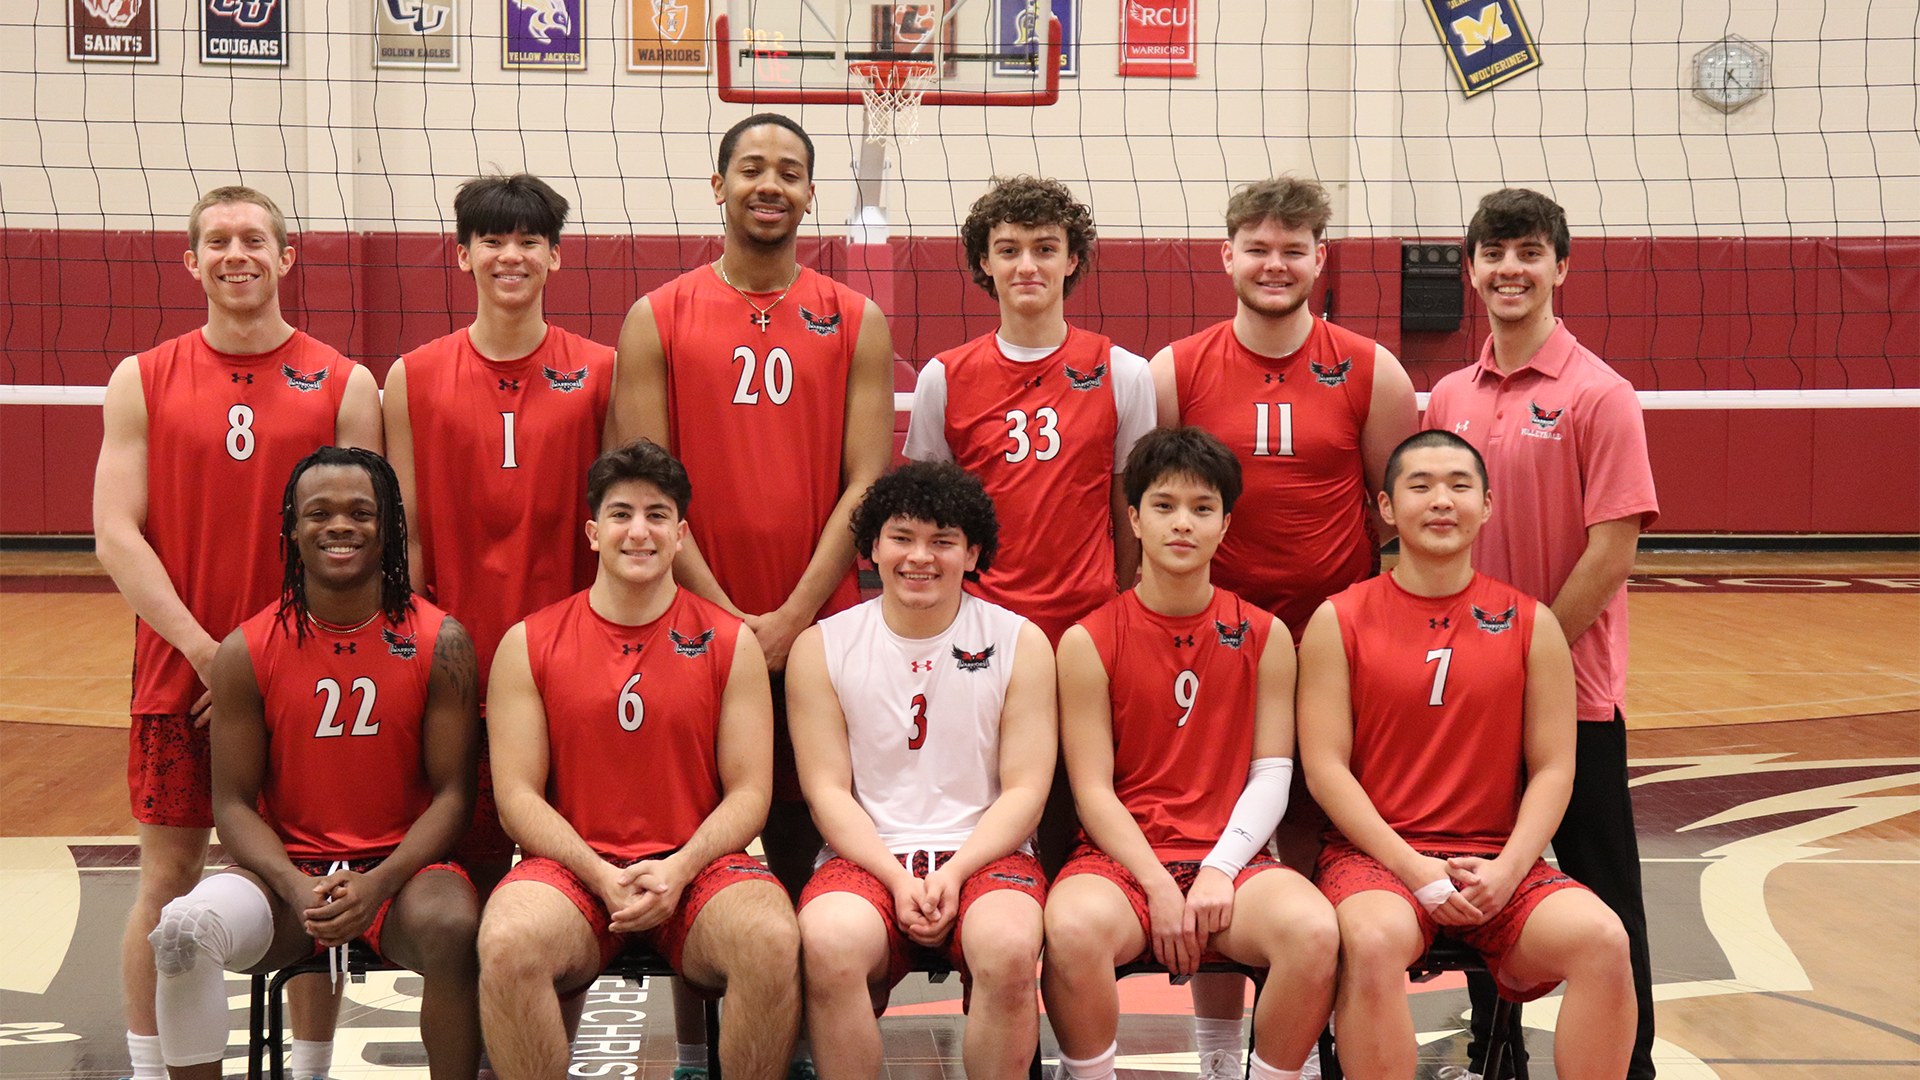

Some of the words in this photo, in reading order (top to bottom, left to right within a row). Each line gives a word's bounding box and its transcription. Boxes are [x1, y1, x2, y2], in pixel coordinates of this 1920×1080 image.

[84, 35, 143, 53] SAINTS
[1141, 7, 1187, 26] RCU
[1451, 1, 1512, 57] M
[209, 38, 279, 56] COUGARS
[381, 47, 415, 57] GOLDEN
[417, 48, 451, 58] EAGLES
[508, 51, 542, 62] YELLOW
[543, 52, 580, 62] JACKETS
[637, 48, 701, 62] WARRIORS
[1131, 45, 1186, 55] WARRIORS
[1468, 49, 1529, 84] WOLVERINES
[731, 345, 794, 406] 20
[225, 403, 256, 462] 8
[498, 411, 520, 469] 1
[1004, 406, 1062, 464] 33
[1253, 402, 1296, 457] 11
[616, 672, 643, 733] 6
[1173, 668, 1200, 728] 9
[1424, 647, 1453, 707] 7
[313, 675, 382, 739] 22
[907, 693, 928, 751] 3
